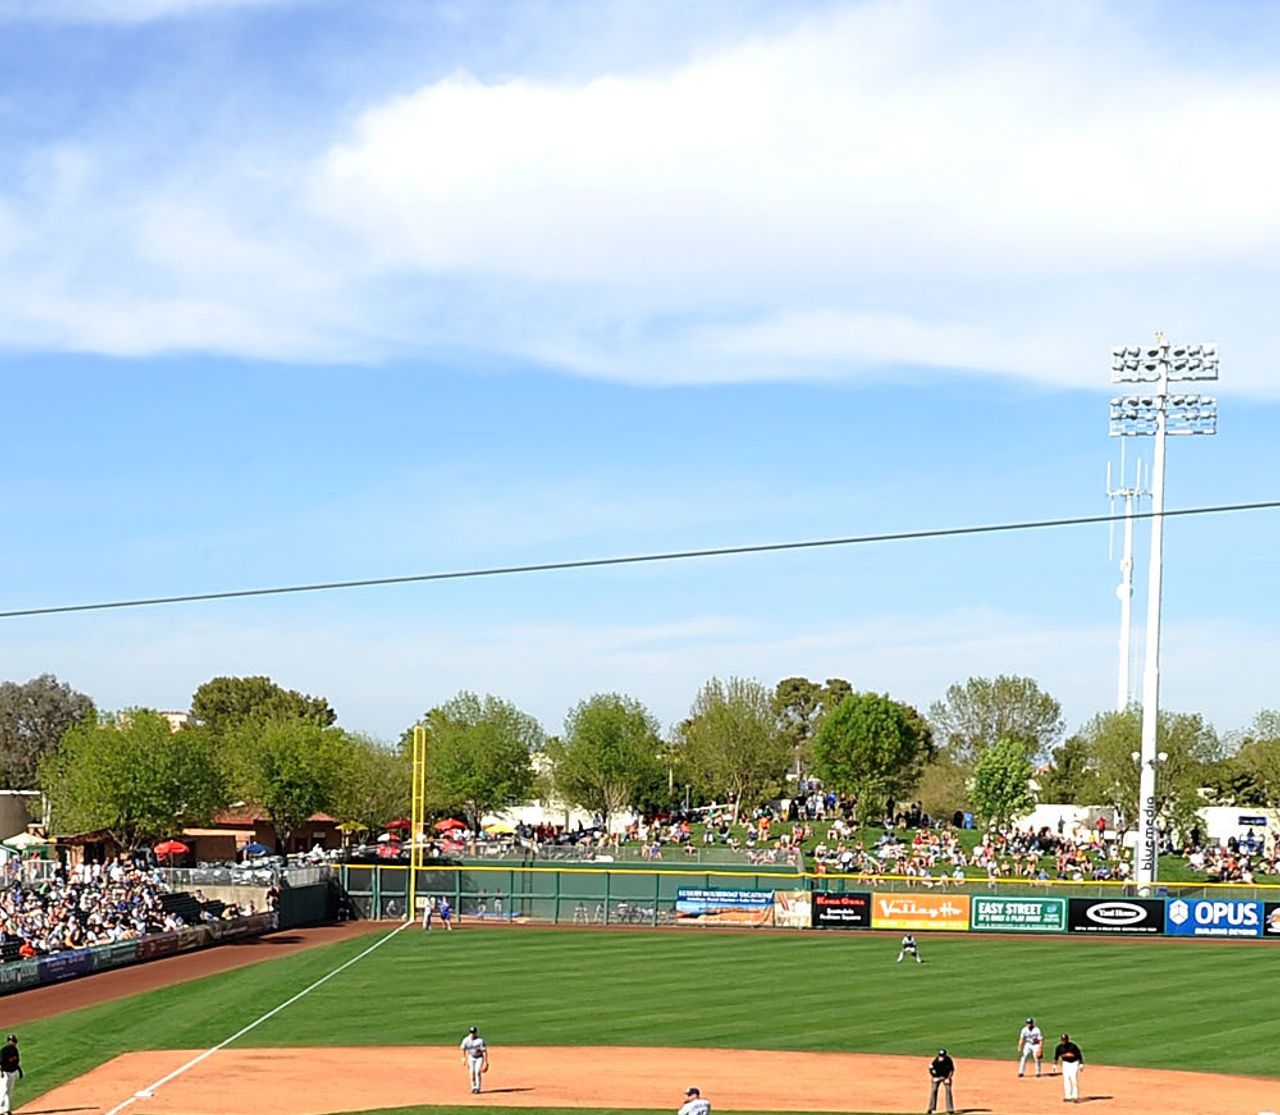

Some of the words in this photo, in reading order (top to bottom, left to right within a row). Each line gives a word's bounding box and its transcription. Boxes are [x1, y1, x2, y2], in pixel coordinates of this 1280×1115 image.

[1141, 796, 1155, 871] bluemedia
[978, 902, 1003, 915] EASY
[1005, 903, 1042, 915] STREET
[1194, 902, 1258, 924] OPUS
